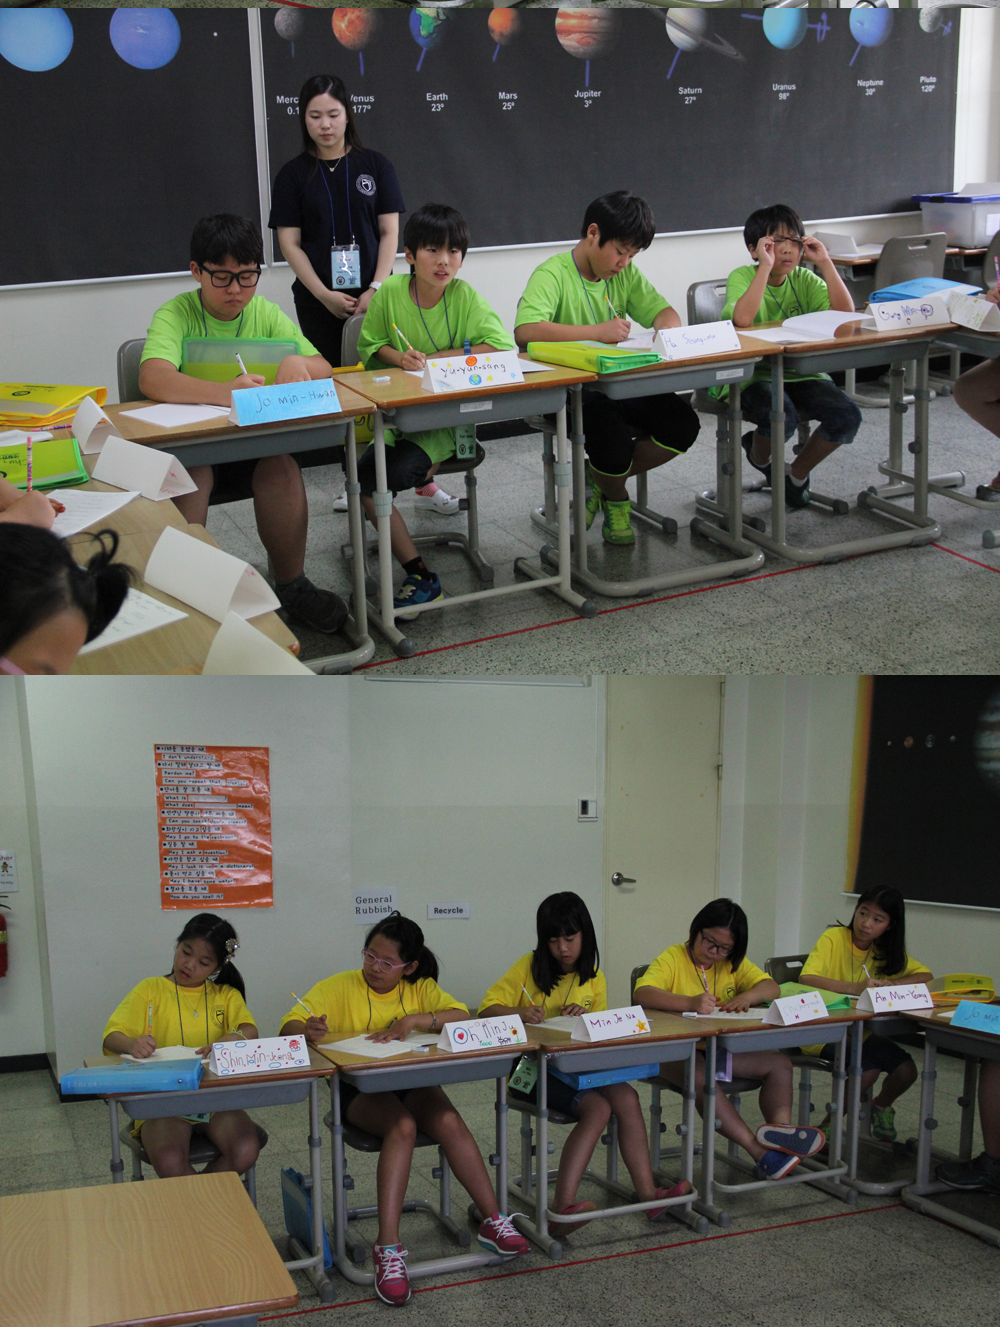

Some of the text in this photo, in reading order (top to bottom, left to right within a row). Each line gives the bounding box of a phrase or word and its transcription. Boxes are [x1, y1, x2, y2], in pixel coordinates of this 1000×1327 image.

[857, 79, 884, 87] Neptune
[574, 90, 601, 98] Jupiter
[678, 87, 702, 95] Saturn
[276, 95, 299, 104] Merc
[426, 93, 448, 101] Earth
[498, 92, 517, 100] Mars
[356, 895, 392, 904] General
[356, 905, 392, 914] Rubbish
[875, 992, 886, 1003] An
